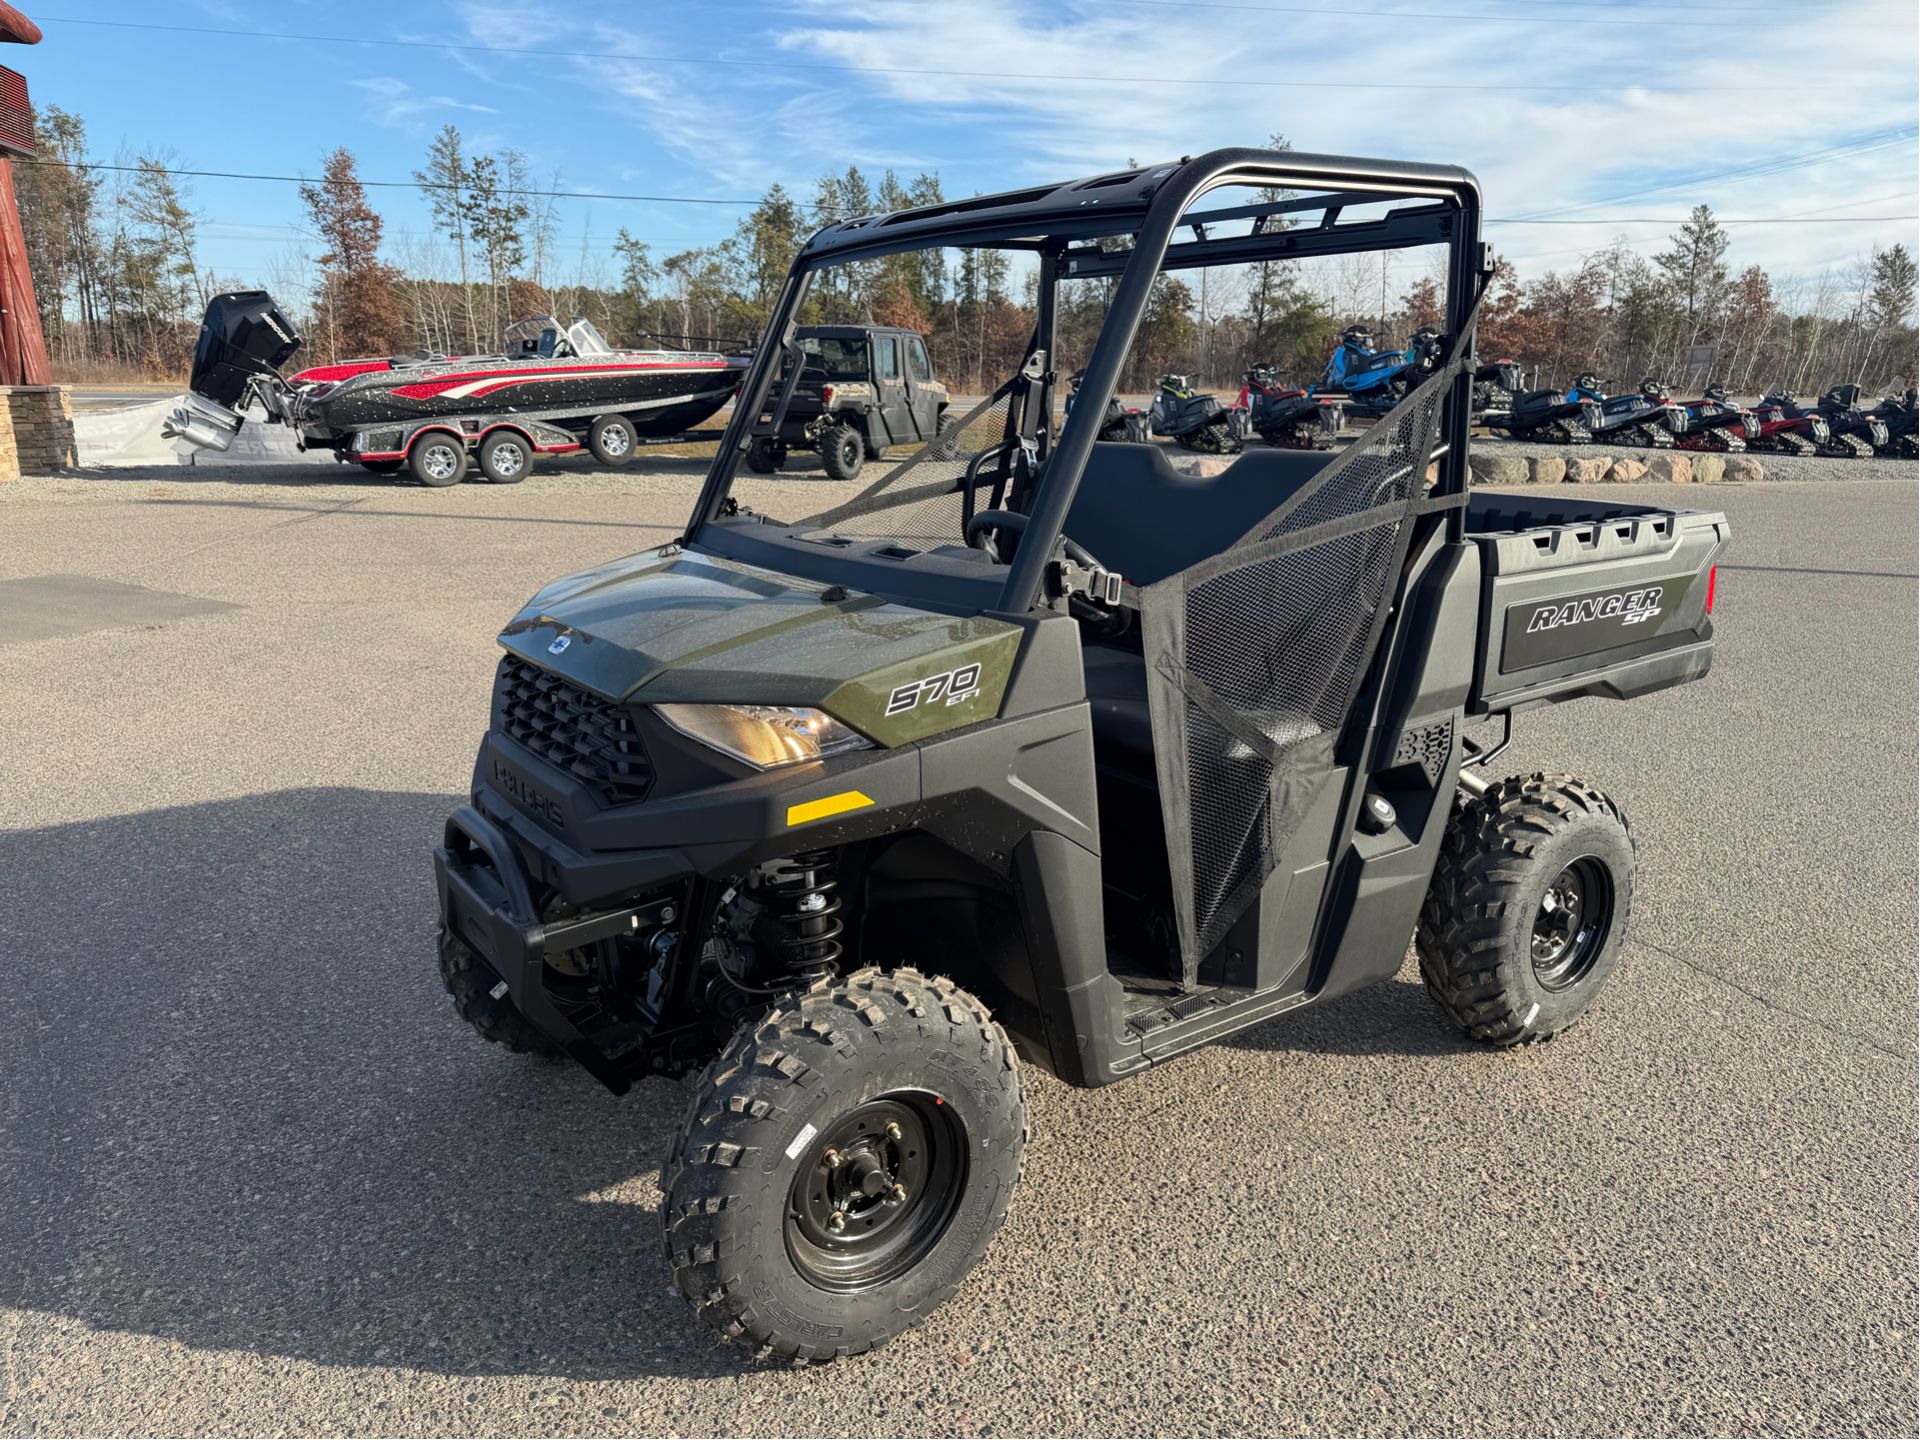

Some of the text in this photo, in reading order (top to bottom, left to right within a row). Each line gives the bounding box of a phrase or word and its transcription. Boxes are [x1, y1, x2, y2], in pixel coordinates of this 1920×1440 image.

[1526, 587, 1663, 633] RANGER
[1621, 608, 1661, 626] SP
[884, 662, 982, 717] 570
[945, 688, 981, 707] EFI
